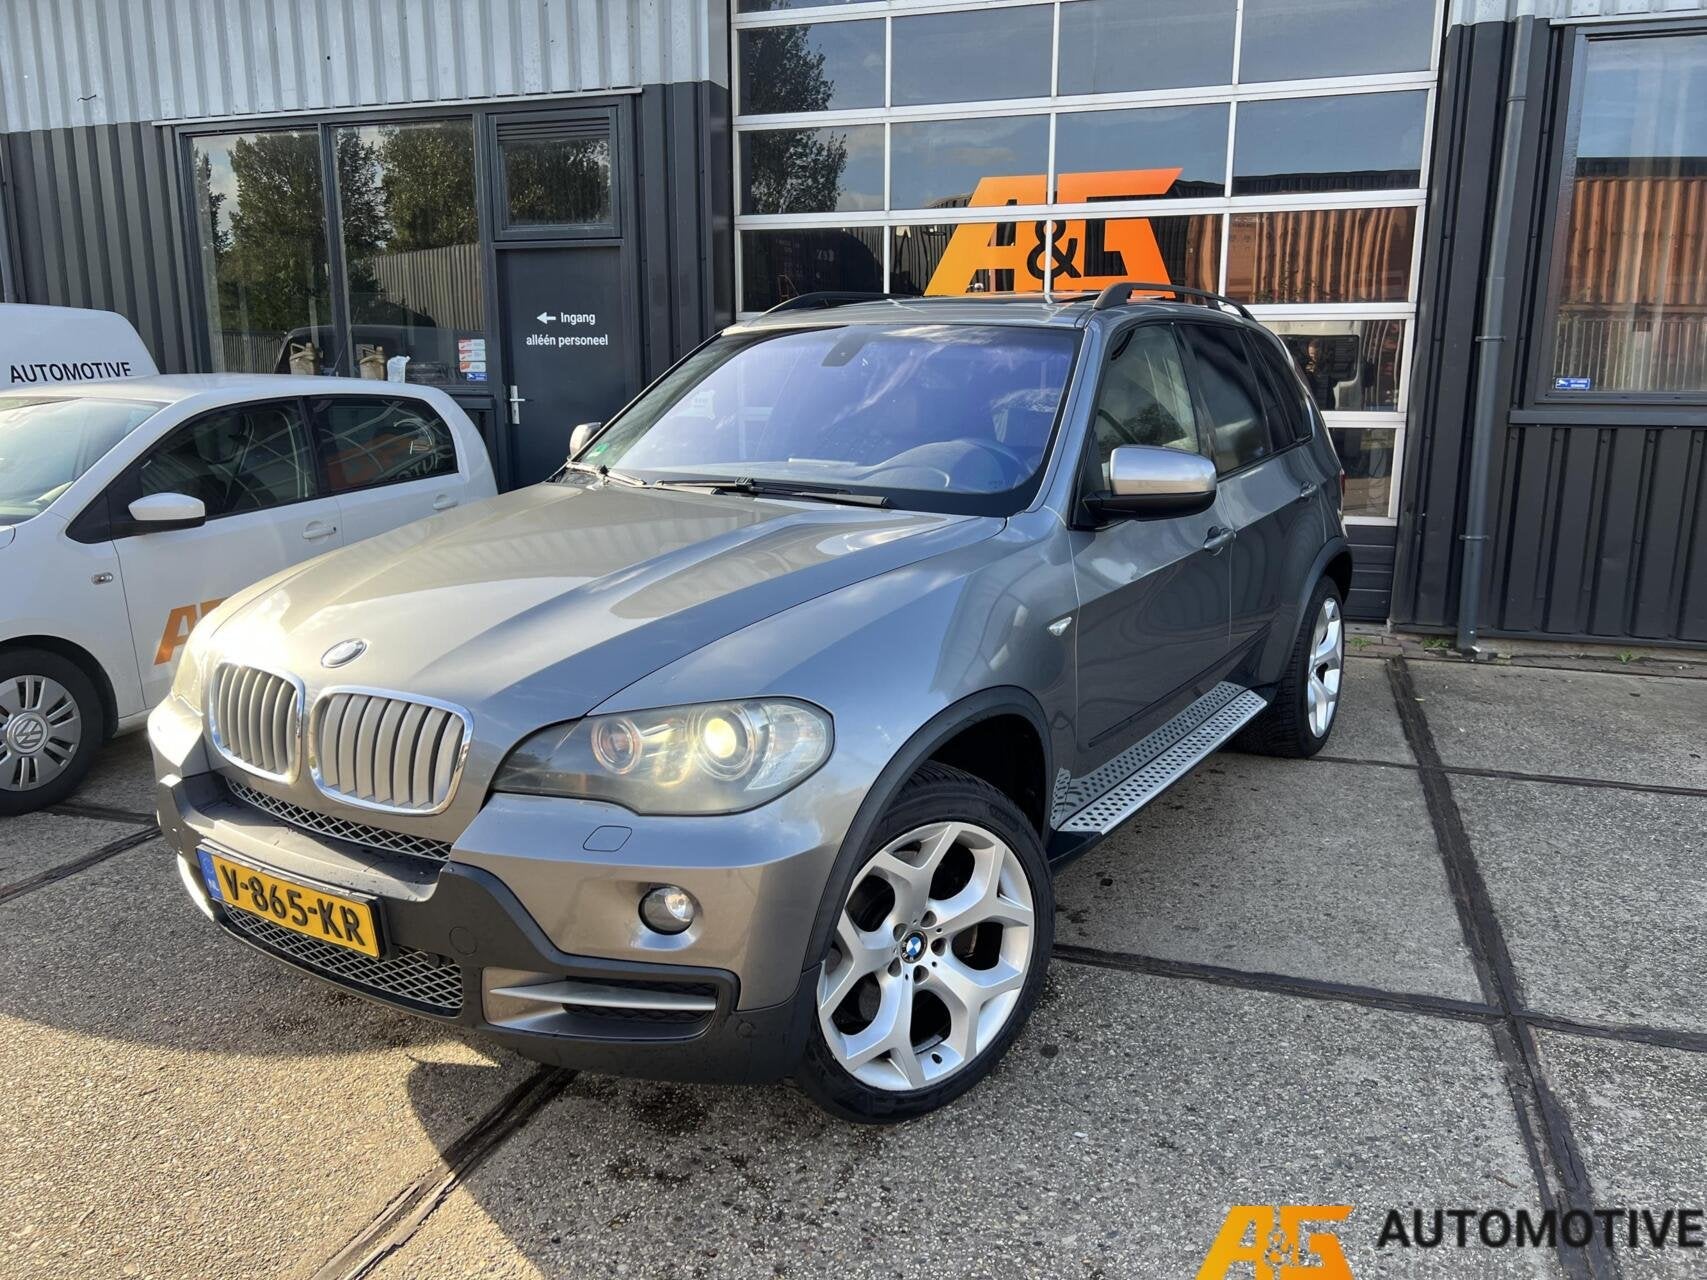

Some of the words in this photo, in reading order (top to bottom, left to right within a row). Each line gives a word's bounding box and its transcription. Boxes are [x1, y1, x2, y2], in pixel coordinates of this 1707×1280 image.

[923, 167, 1183, 298] A&G
[560, 312, 596, 326] Ingang
[526, 334, 556, 345] alléén
[558, 334, 608, 348] personeel
[10, 362, 131, 383] AUTOMOTIVE
[219, 863, 366, 947] V-865-KR
